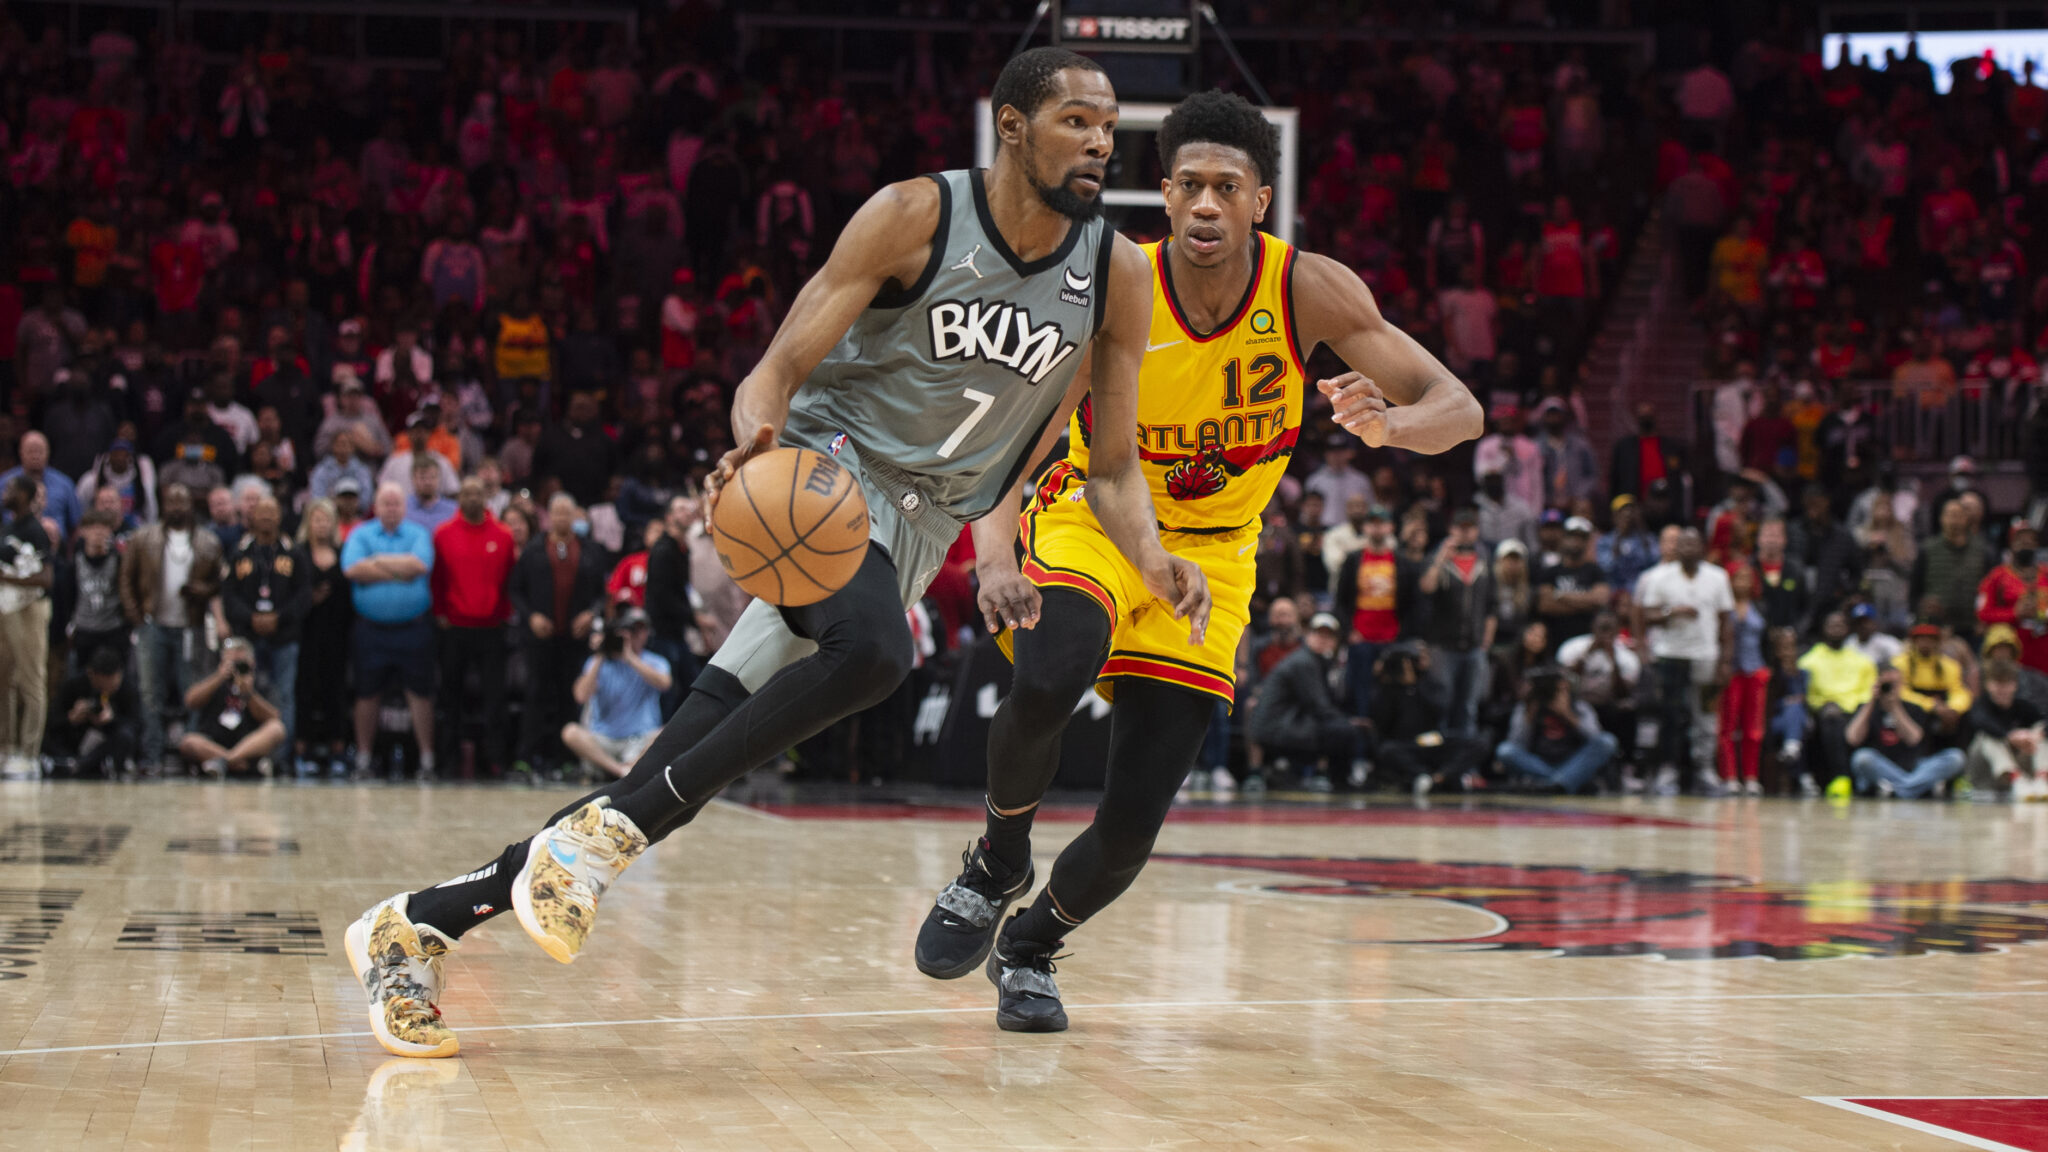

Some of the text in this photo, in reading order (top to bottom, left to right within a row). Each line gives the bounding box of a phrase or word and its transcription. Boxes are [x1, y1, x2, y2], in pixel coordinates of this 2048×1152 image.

[1099, 17, 1190, 39] TISSOT
[1061, 291, 1088, 306] Webull
[929, 300, 1077, 385] BKLYN
[1245, 336, 1282, 345] sharecare
[1222, 352, 1287, 409] 12
[936, 387, 996, 459] 7
